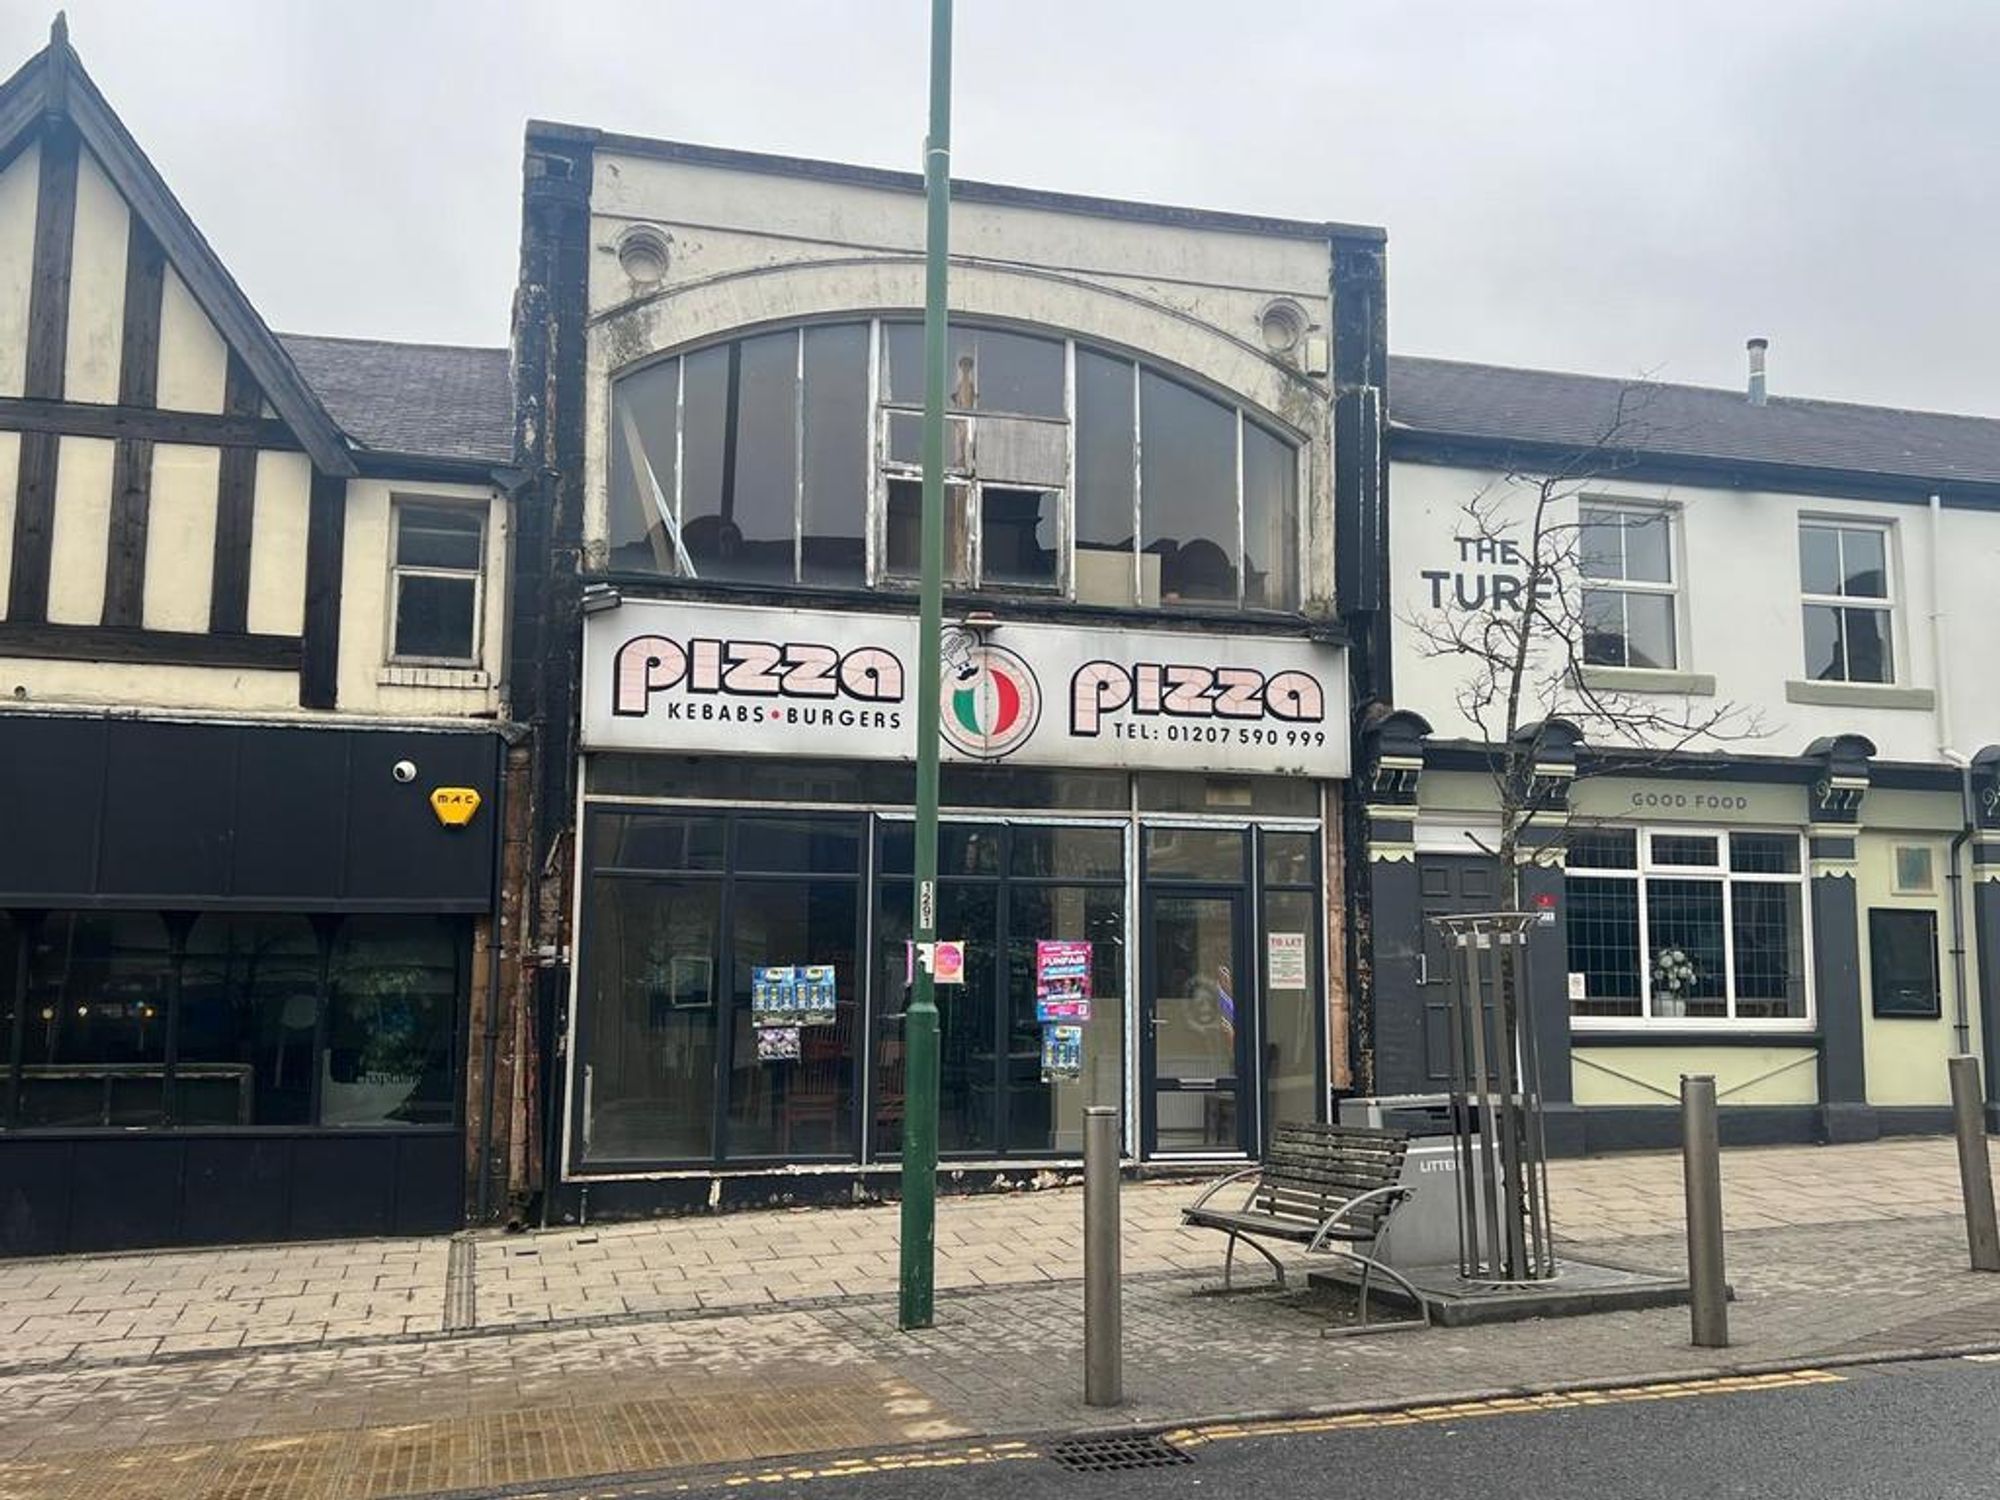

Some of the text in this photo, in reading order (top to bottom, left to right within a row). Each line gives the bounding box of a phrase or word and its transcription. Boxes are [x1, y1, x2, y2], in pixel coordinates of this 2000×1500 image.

[1453, 537, 1519, 565] THE
[668, 702, 901, 728] KEBABS BURGERS
[1113, 722, 1326, 747] TEL: 01207 590 999
[1632, 792, 1748, 810] GOOD FOOD
